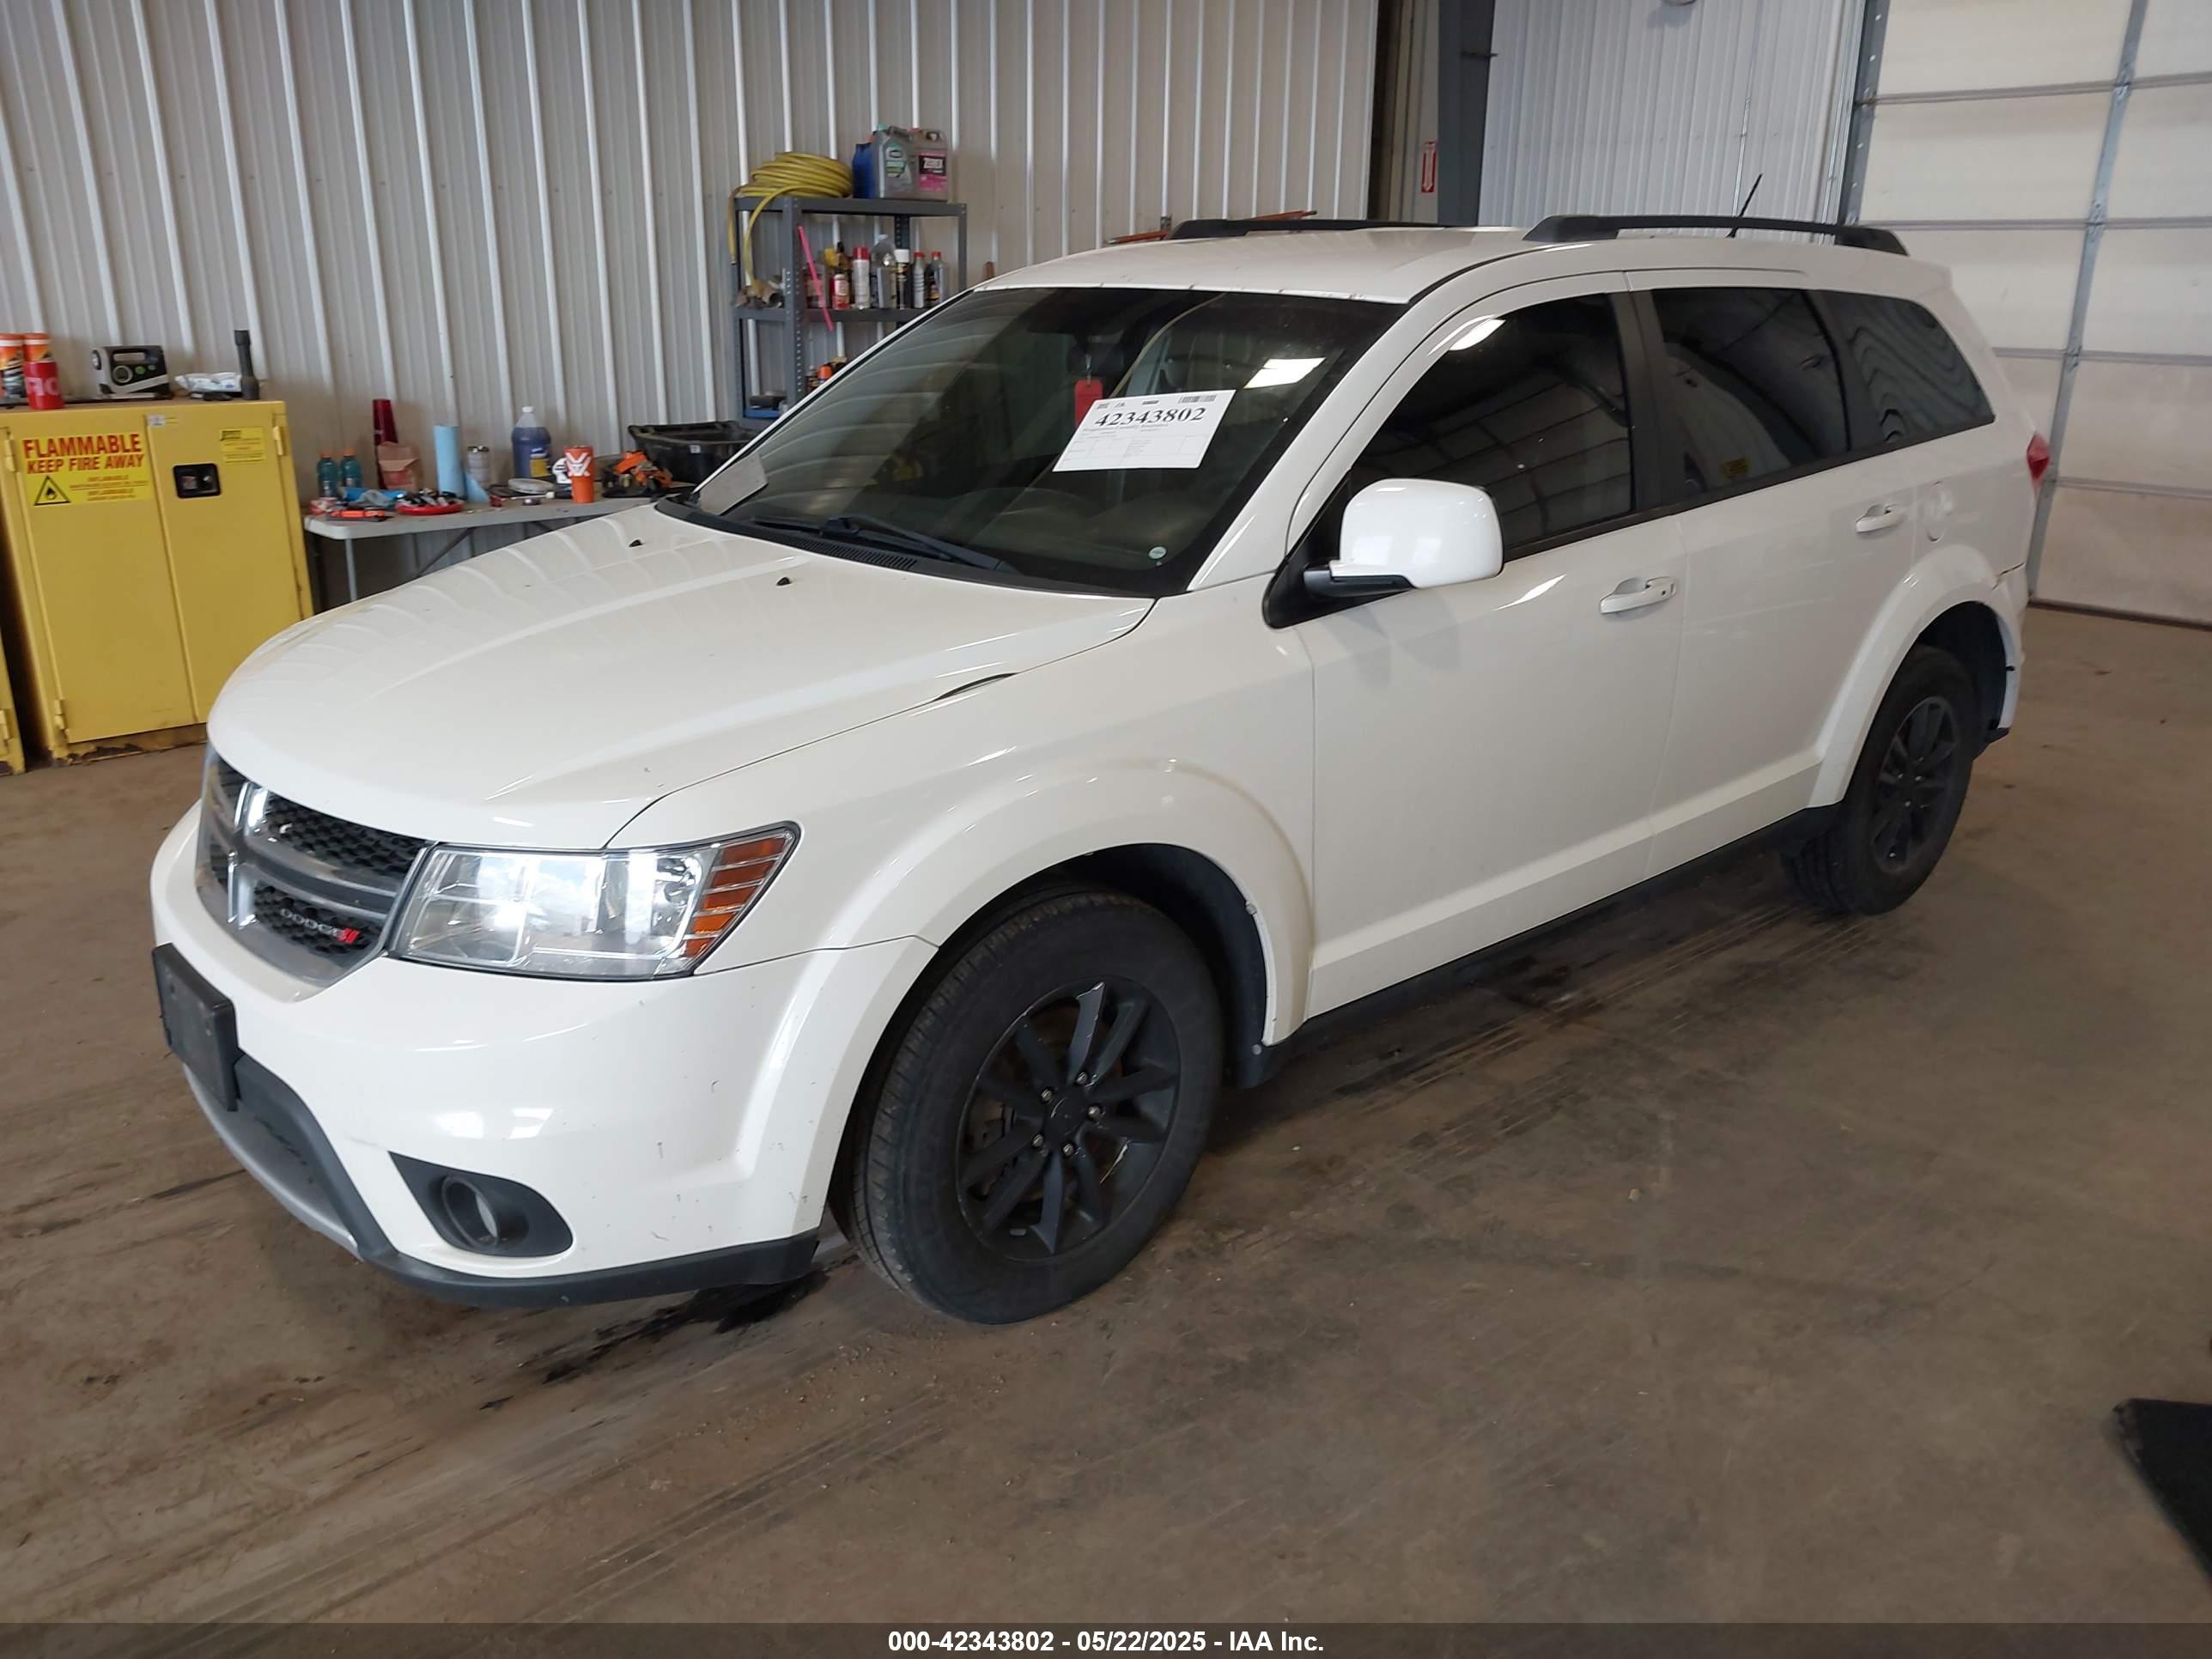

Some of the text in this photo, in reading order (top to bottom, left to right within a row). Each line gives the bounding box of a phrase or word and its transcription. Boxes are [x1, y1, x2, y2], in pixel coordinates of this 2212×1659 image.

[1094, 407, 1206, 426] 42343802
[22, 433, 142, 459] FLAMMABLE
[27, 453, 144, 475] KEEP FIRE AWAY
